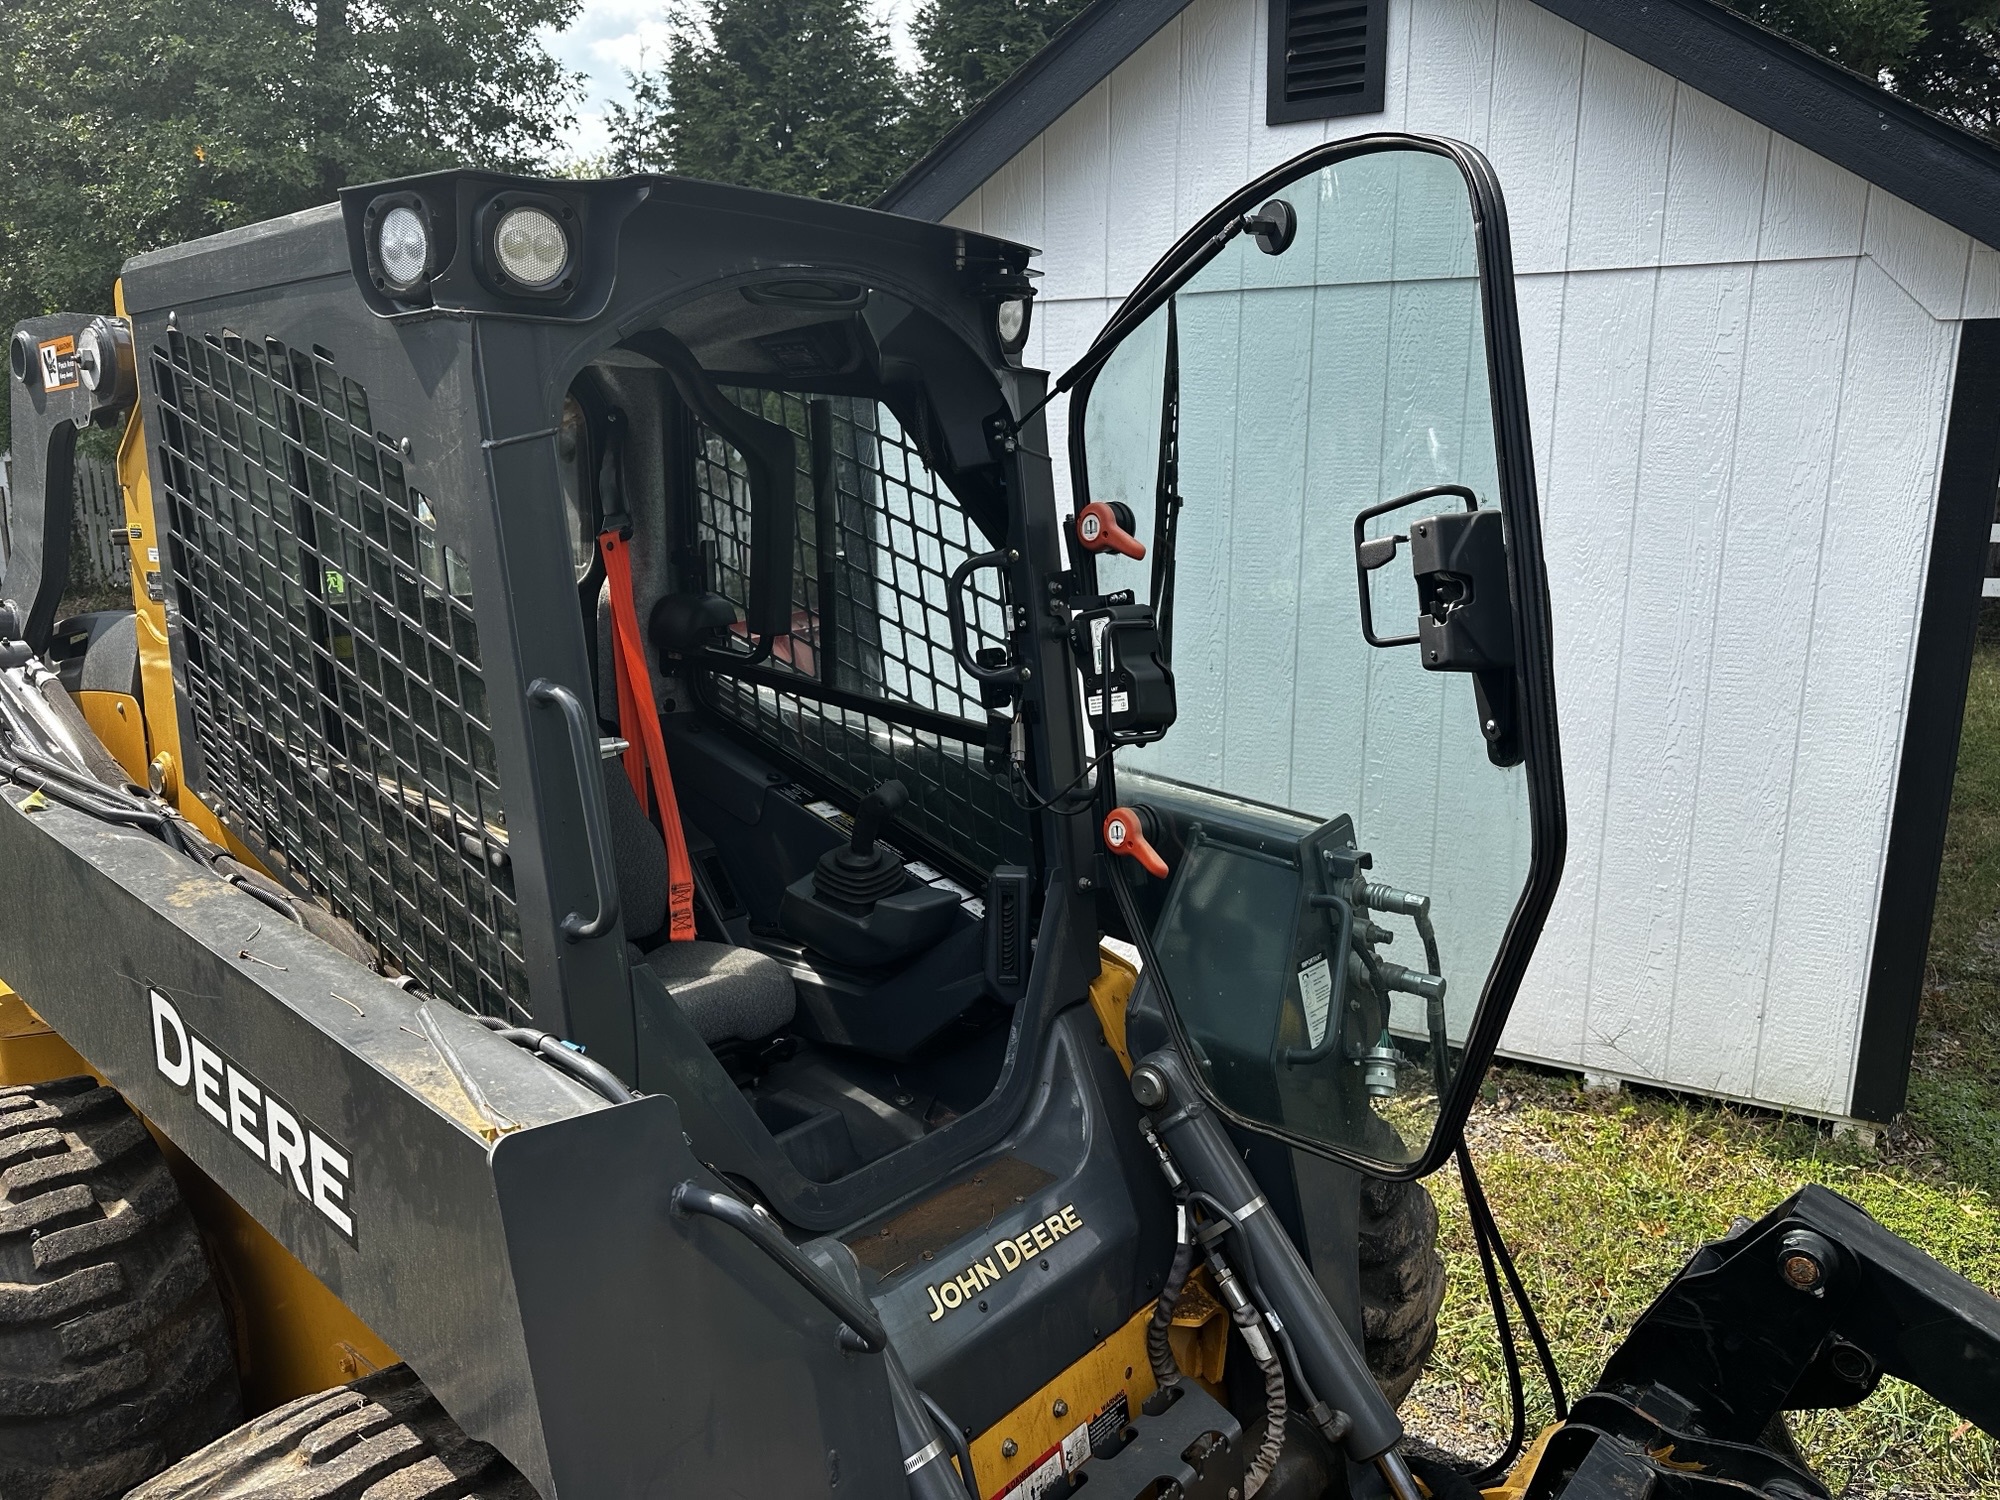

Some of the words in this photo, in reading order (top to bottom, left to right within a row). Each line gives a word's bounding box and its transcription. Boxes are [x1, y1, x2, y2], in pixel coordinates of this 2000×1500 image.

[150, 989, 353, 1238] DEERE
[927, 1257, 1001, 1323] JOHN
[994, 1203, 1084, 1273] DEERE
[1100, 1388, 1125, 1412] WARNING
[1010, 1463, 1037, 1487] DANGER
